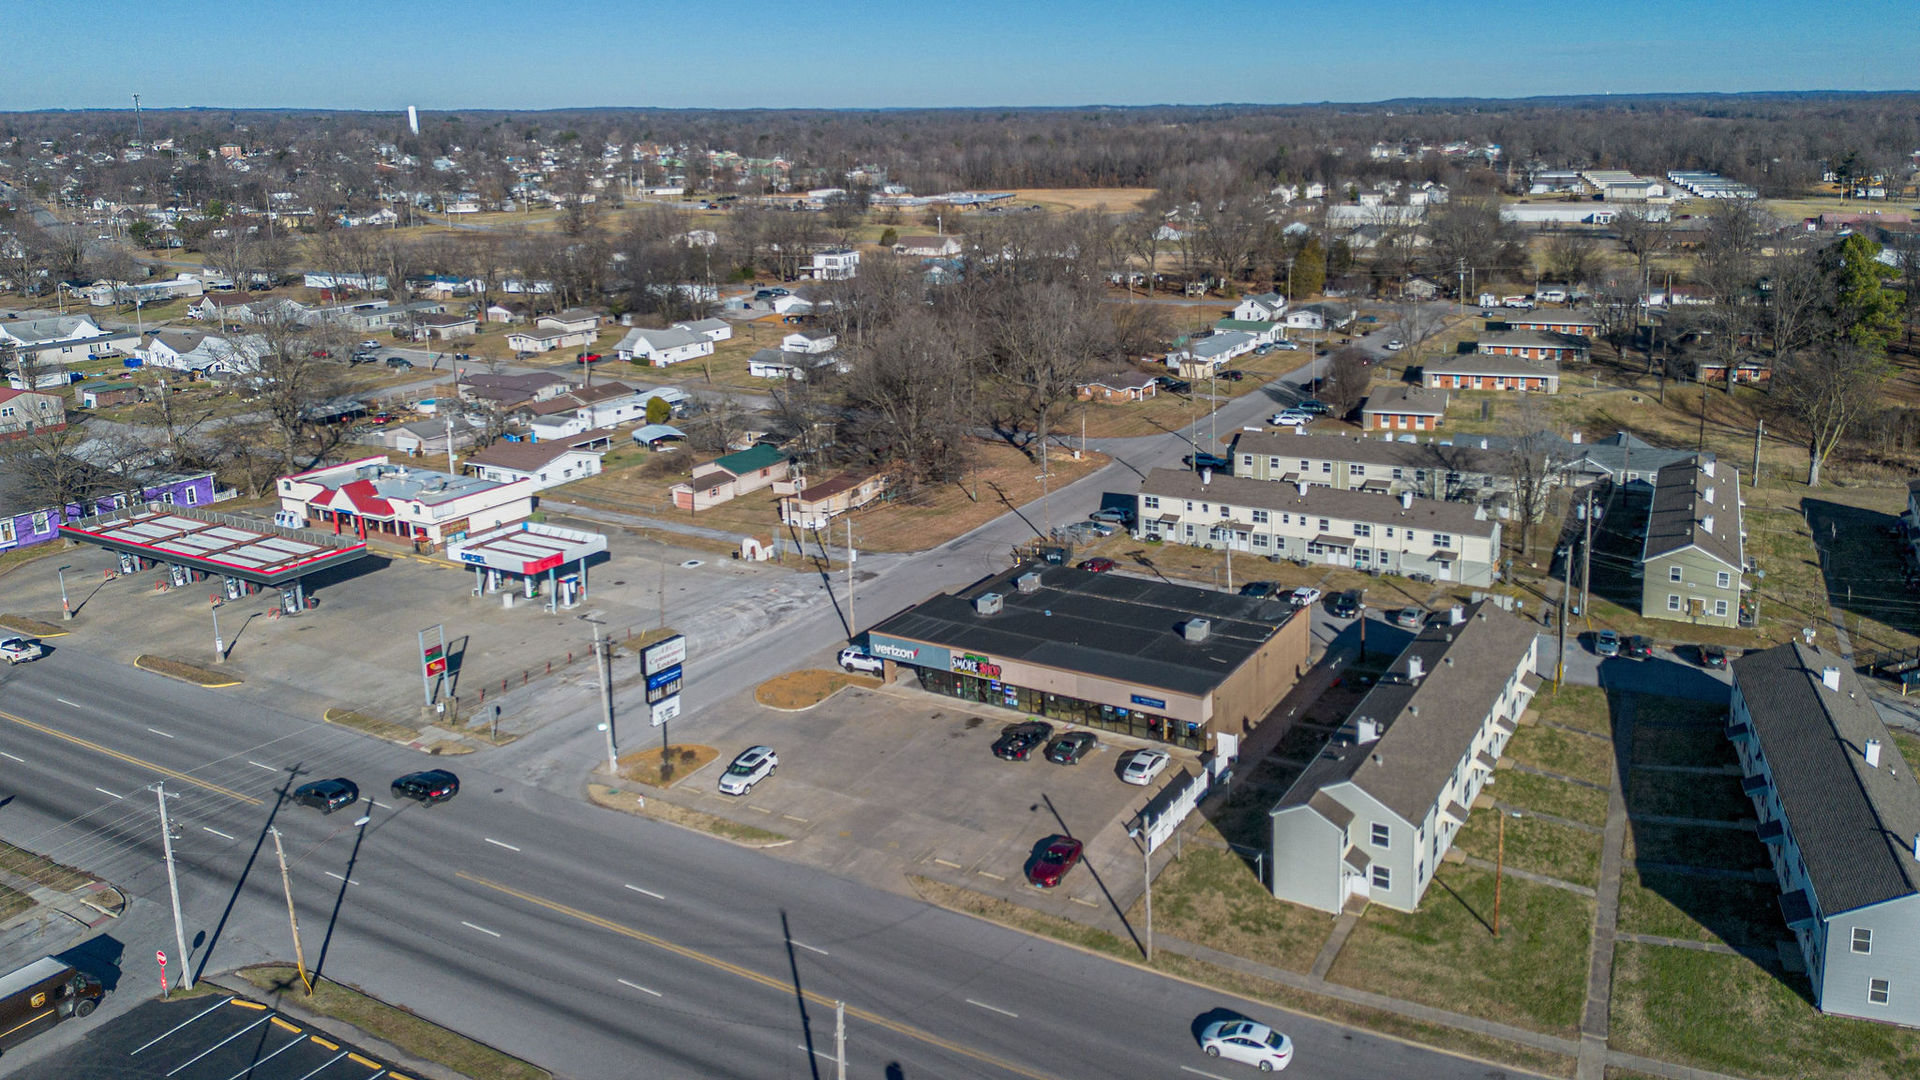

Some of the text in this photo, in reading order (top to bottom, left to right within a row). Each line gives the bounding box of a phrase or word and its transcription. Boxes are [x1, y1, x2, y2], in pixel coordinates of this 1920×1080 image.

[460, 552, 487, 565] DIESEL
[874, 643, 915, 660] verizon
[952, 656, 978, 672] SMOKE
[979, 663, 1001, 676] SHOP
